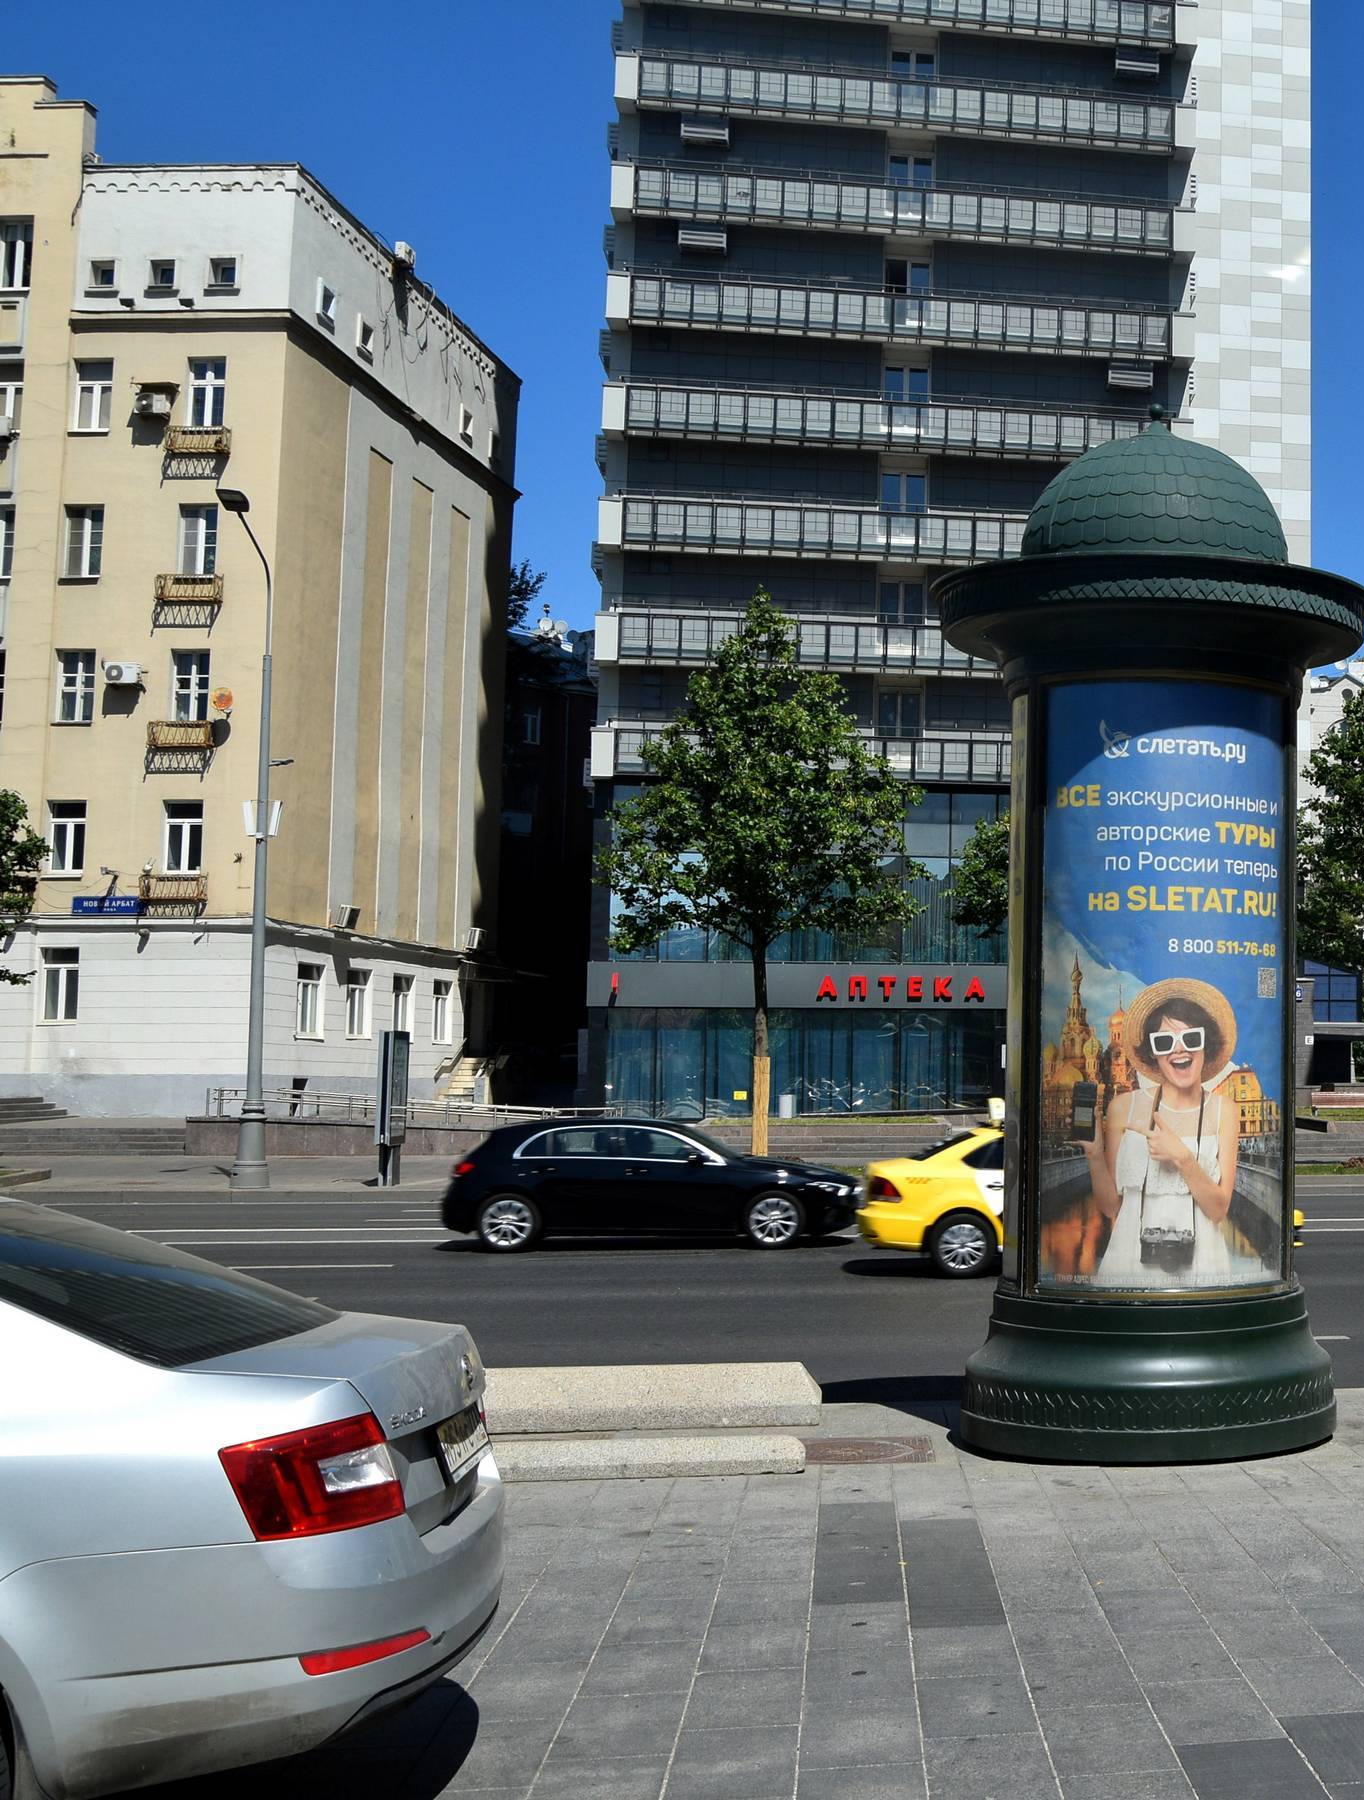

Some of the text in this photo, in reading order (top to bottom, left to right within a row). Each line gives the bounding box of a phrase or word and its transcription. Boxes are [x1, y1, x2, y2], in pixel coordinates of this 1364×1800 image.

[1136, 737, 1247, 764] слетать.ру
[1056, 784, 1278, 816] ВСЕ экскурсионные и
[1096, 821, 1276, 849] авторские ТУРЫ
[1105, 851, 1278, 882] по России теперь
[83, 899, 110, 907] НОВЙ
[1088, 885, 1277, 917] на SLETAT.RU!
[1168, 938, 1277, 957] 8 800 511-76-68
[816, 975, 985, 1001] АПТЕКА
